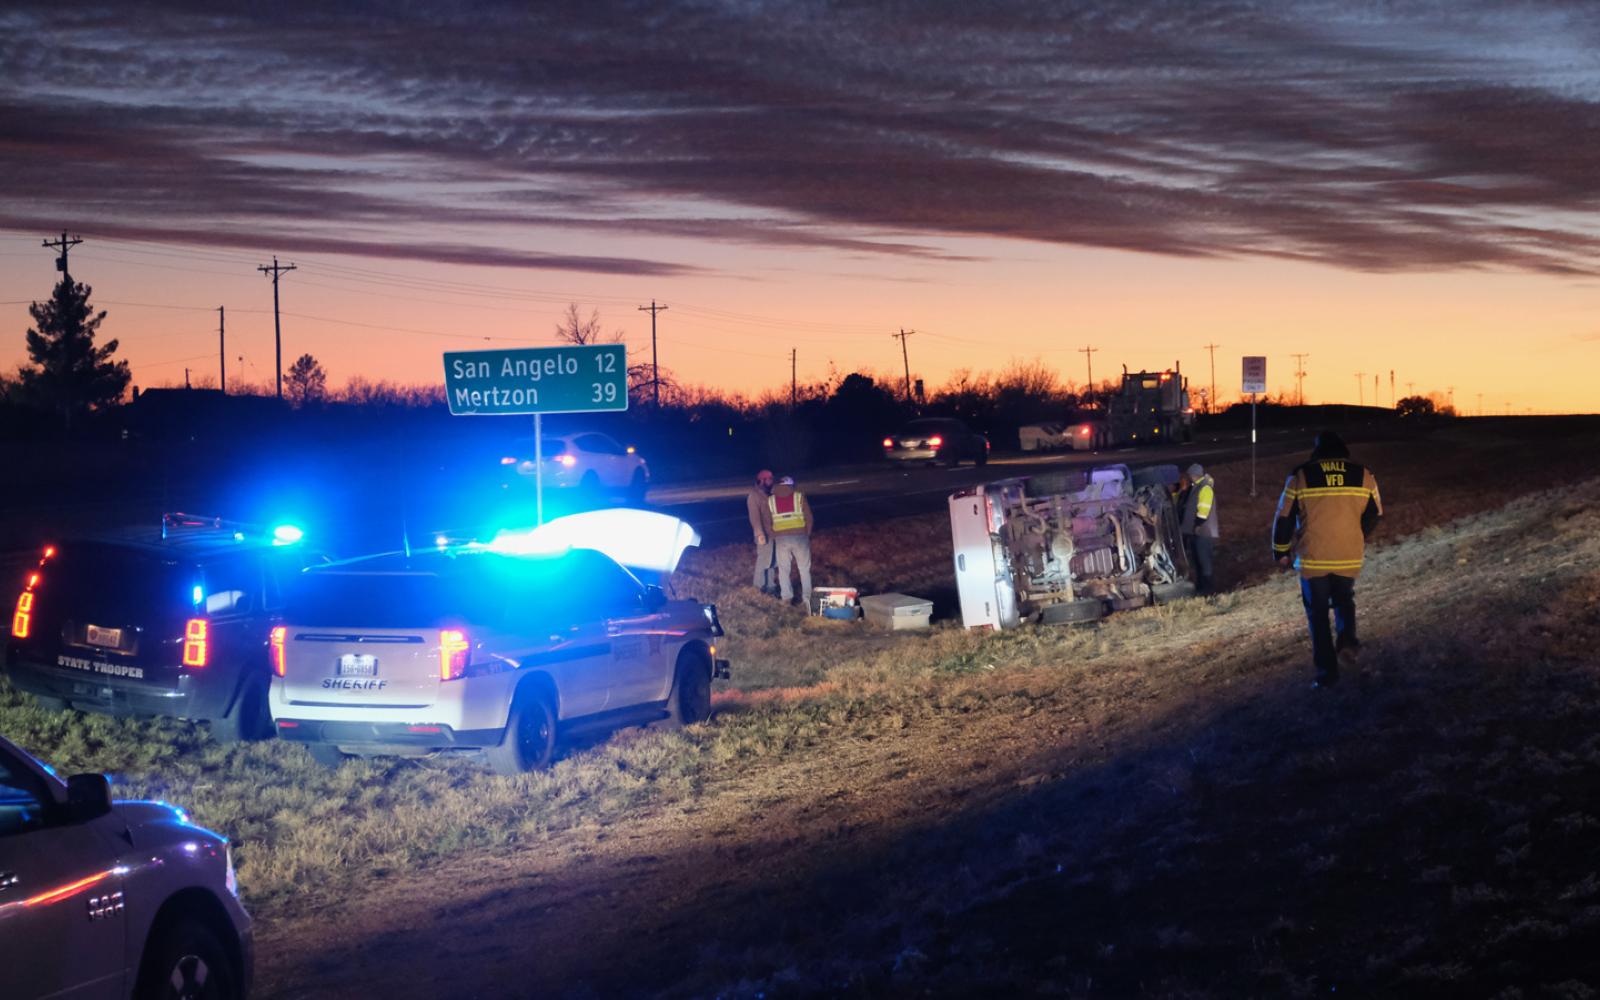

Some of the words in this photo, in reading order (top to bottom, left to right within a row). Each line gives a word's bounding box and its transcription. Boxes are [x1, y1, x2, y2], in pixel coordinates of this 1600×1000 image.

[453, 359, 490, 379] San
[501, 353, 578, 381] Angelo
[595, 352, 616, 374] 12
[455, 386, 538, 407] Mertzon
[591, 382, 617, 403] 39
[1320, 461, 1346, 473] WALL
[1325, 473, 1344, 486] VFD
[57, 655, 90, 670] STATE
[93, 661, 144, 678] TROOPER
[322, 678, 388, 690] SHERIFF
